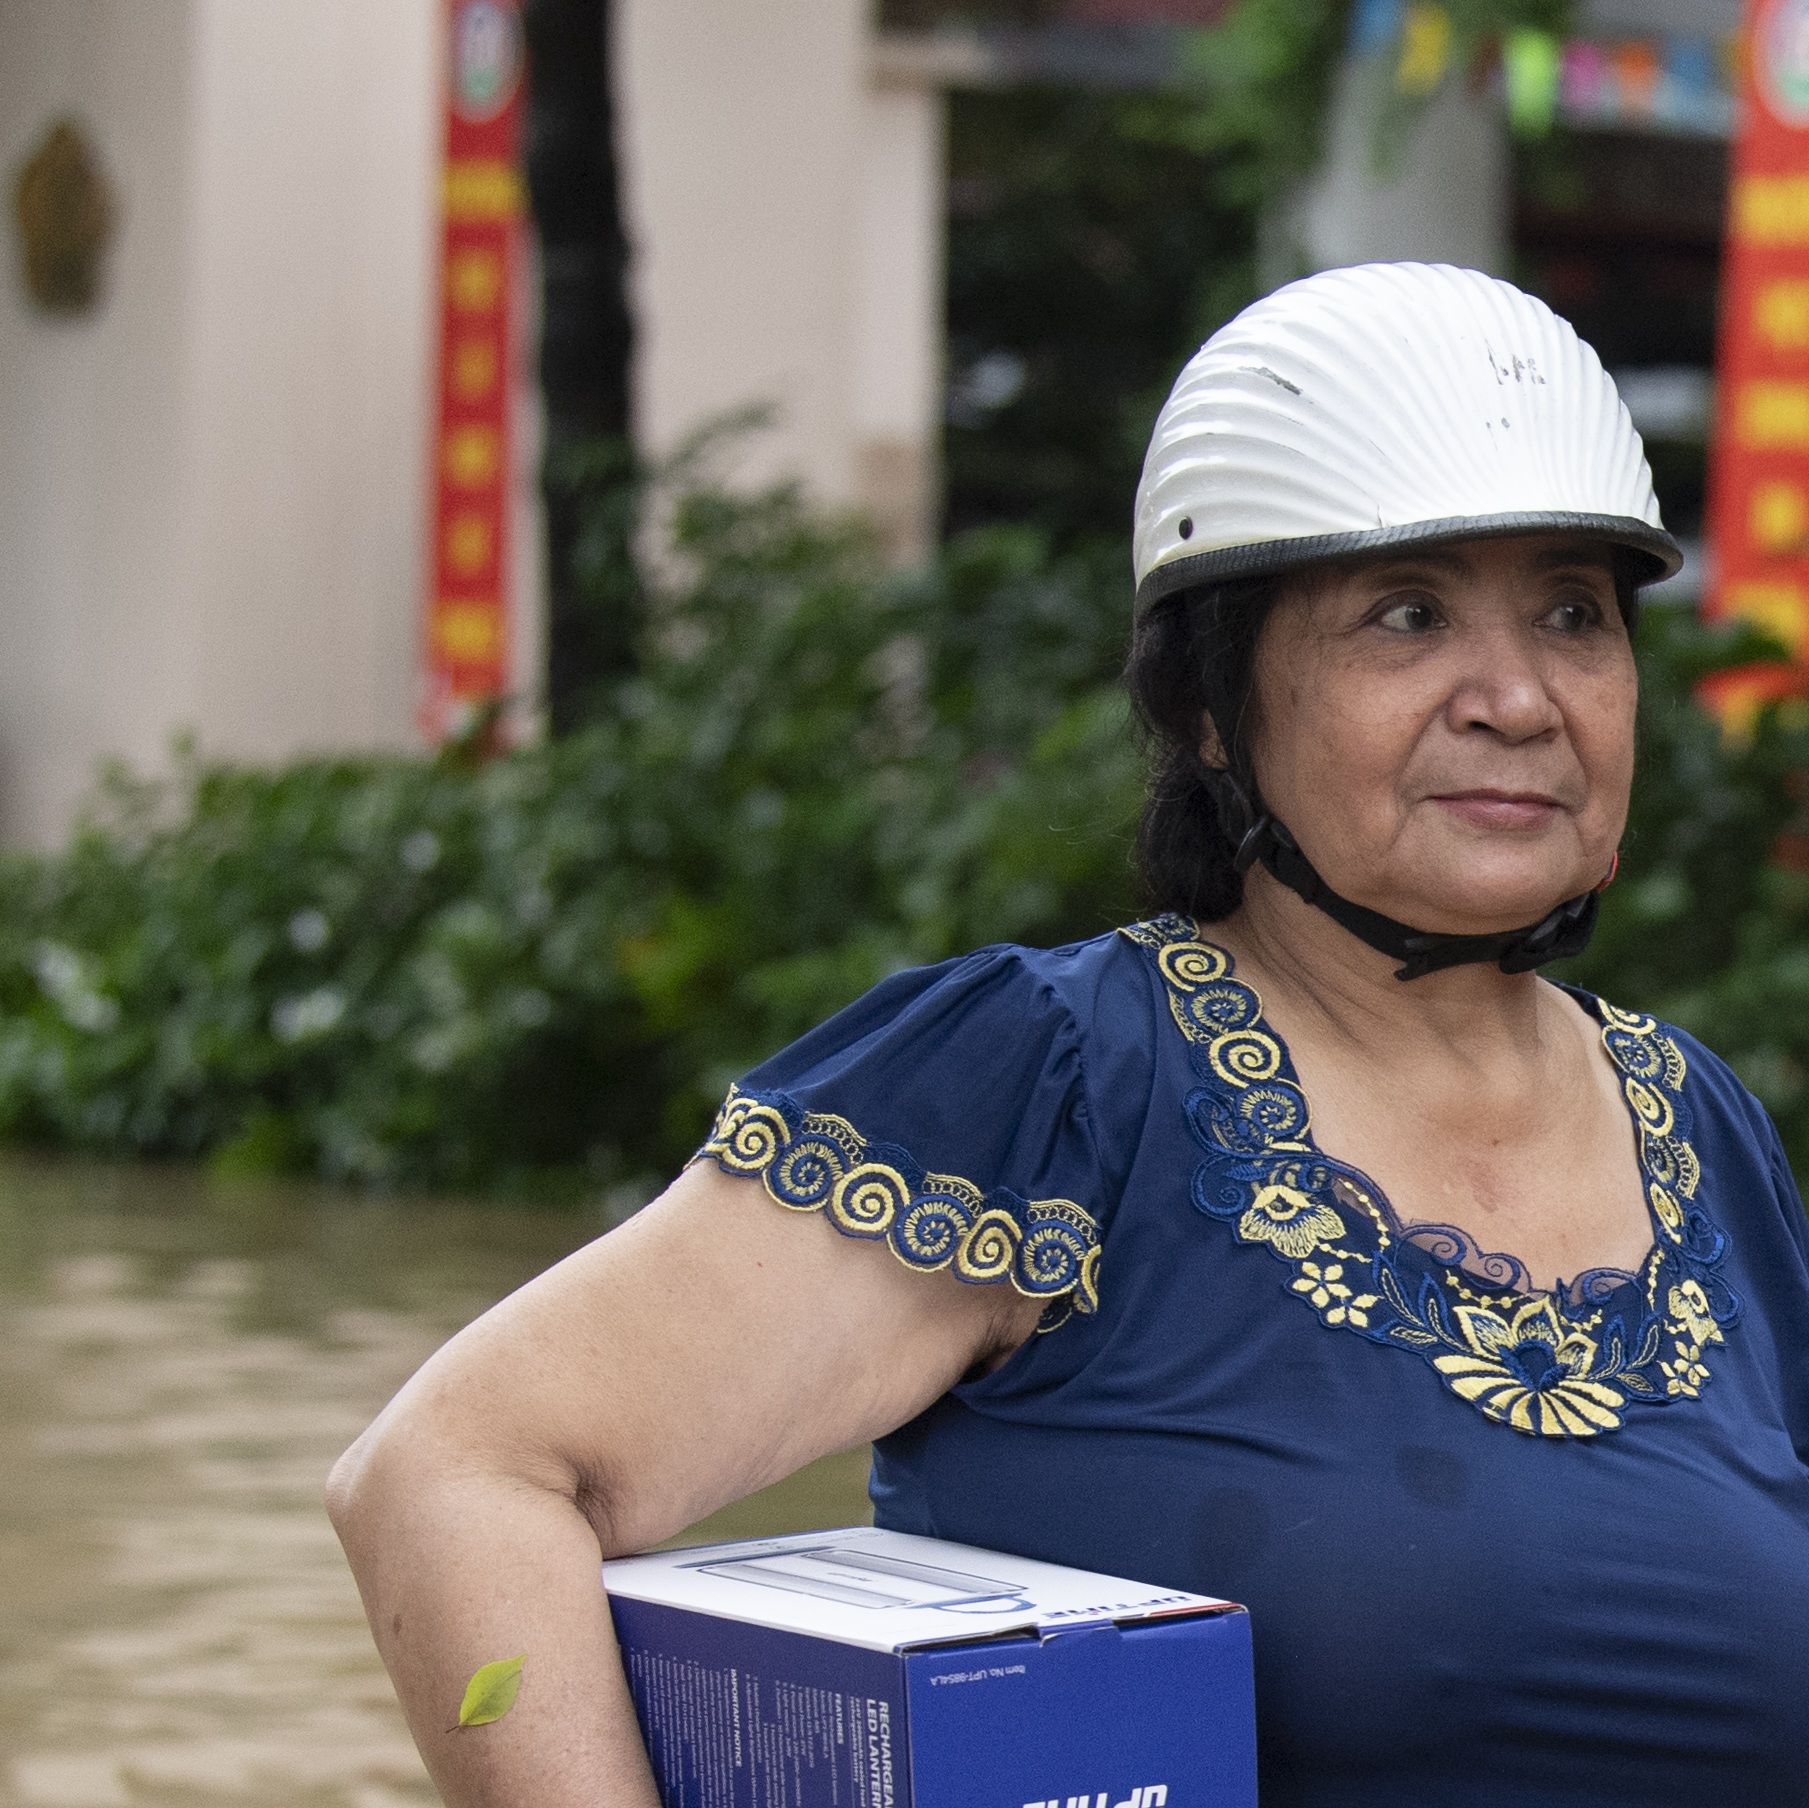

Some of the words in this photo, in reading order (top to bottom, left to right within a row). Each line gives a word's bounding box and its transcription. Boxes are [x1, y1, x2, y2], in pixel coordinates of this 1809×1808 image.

[988, 1665, 1004, 1677] No.
[1004, 1664, 1026, 1676] Item
[730, 1667, 739, 1727] IMPORTANT
[866, 1698, 877, 1732] LED
[834, 1692, 844, 1744] FEATURES
[733, 1729, 741, 1767] NOTICE
